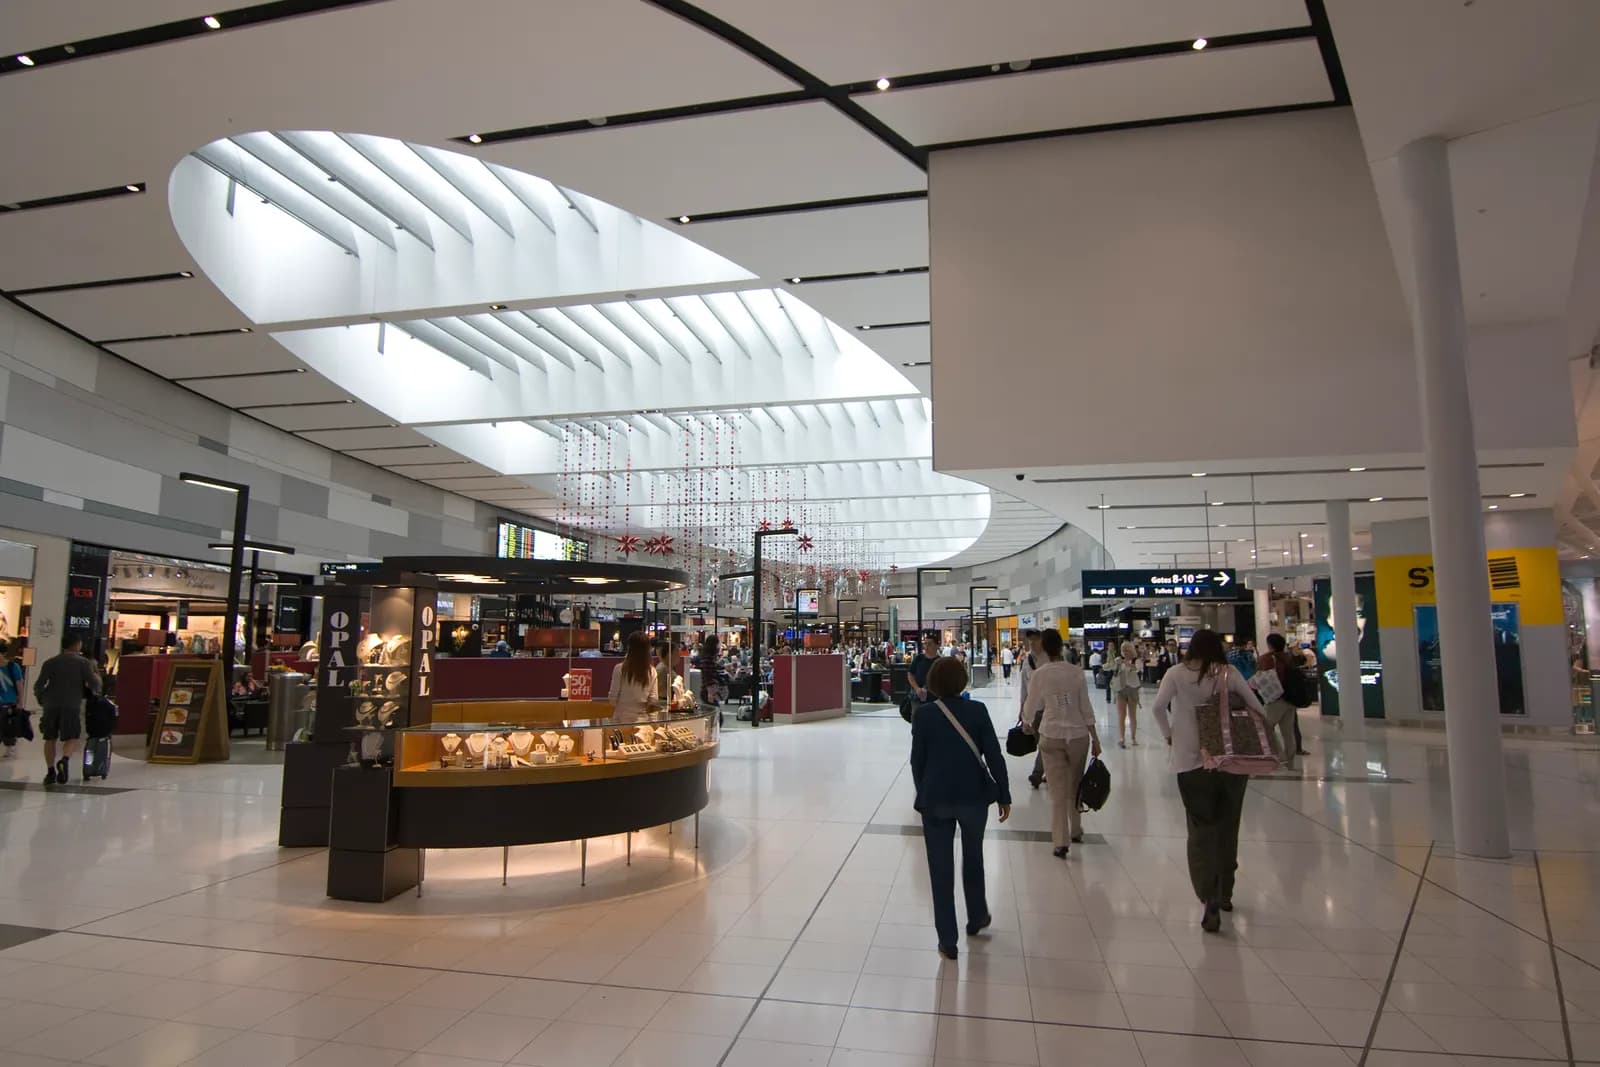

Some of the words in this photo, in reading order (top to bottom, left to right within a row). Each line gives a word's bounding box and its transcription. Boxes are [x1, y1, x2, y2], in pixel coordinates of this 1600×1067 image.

[1172, 574, 1194, 584] 8-10
[70, 616, 90, 625] BOSS
[327, 611, 350, 687] OPAL
[418, 606, 434, 697] OPAL
